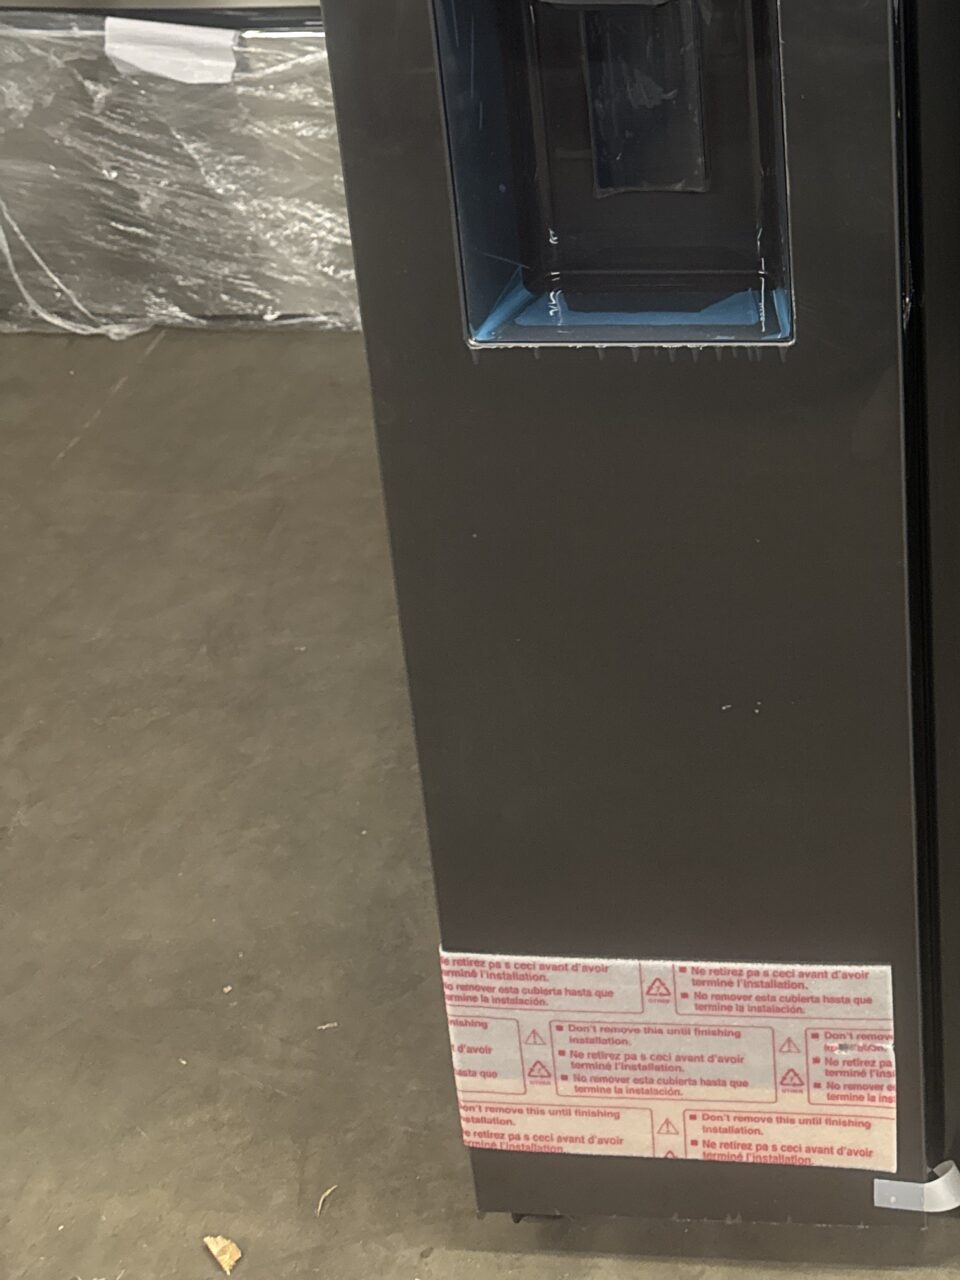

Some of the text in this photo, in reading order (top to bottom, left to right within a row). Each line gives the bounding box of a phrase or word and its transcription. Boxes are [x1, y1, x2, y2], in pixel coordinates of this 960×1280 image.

[690, 967, 707, 976] Ne
[707, 967, 745, 977] retirez
[770, 969, 796, 978] ceci
[797, 969, 829, 979] avant
[830, 970, 869, 980] d'avoir
[693, 992, 873, 1007] No remover esta cubierta hasta que
[695, 1003, 733, 1012] termine
[735, 1004, 745, 1012] la
[701, 1112, 872, 1129] Don't remove this until finishing
[702, 1125, 764, 1135] installation.
